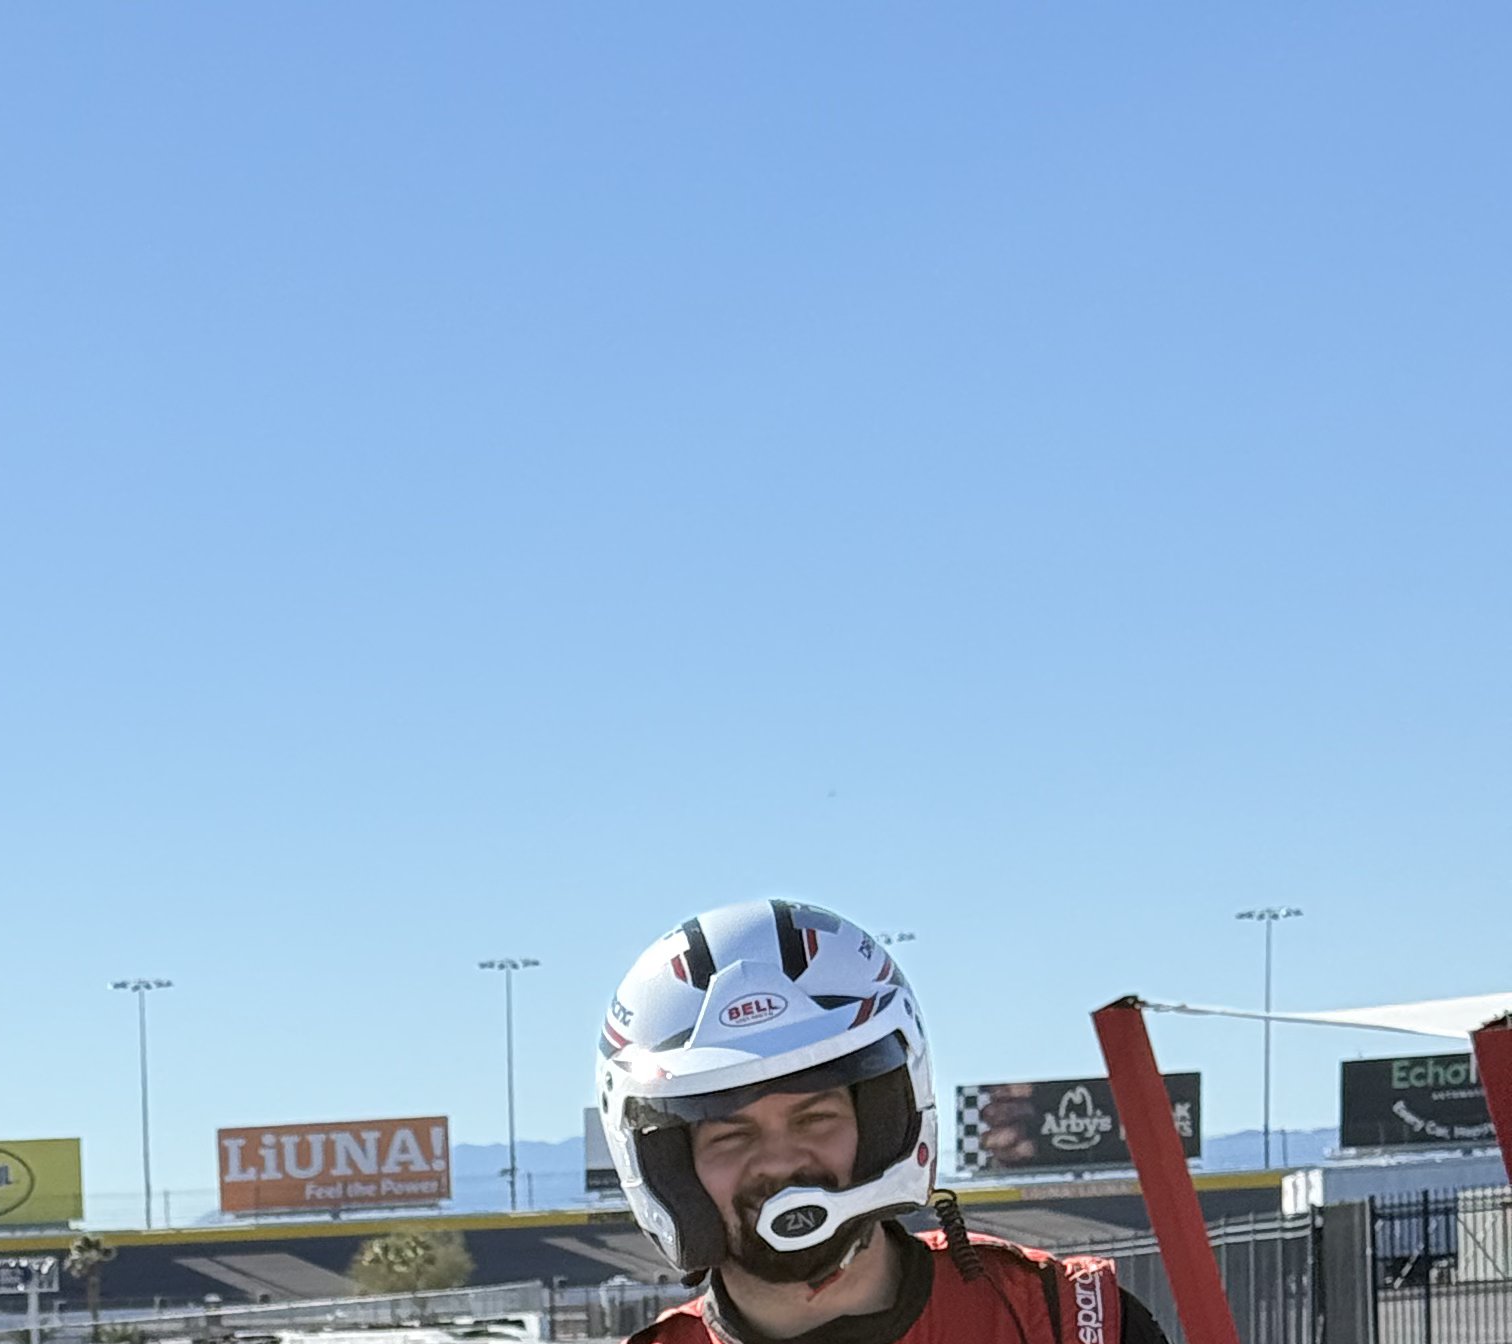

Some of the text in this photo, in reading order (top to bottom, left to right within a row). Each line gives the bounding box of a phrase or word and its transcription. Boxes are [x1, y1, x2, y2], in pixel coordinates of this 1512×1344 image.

[729, 998, 780, 1021] BELL
[1041, 1110, 1112, 1138] Arby's
[223, 1126, 447, 1183] LiUNA!
[305, 1182, 344, 1200] Feel
[347, 1181, 376, 1198] the
